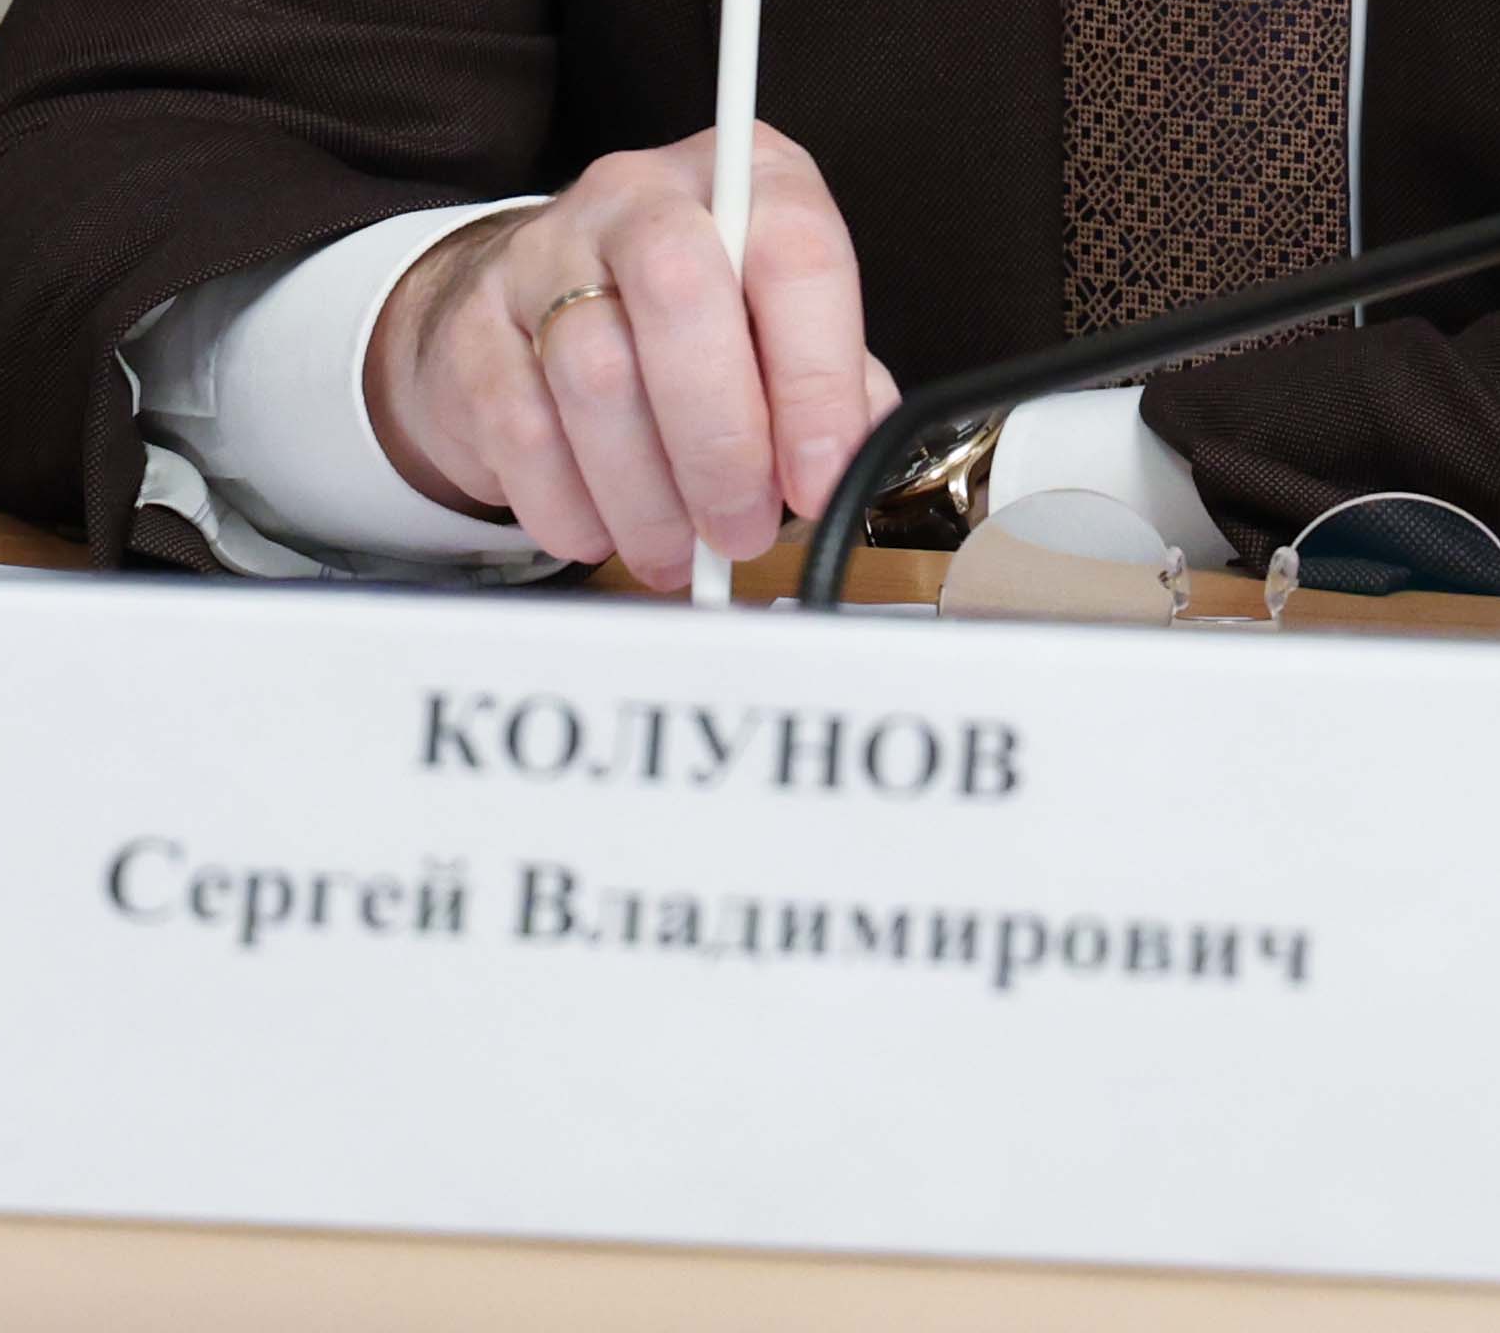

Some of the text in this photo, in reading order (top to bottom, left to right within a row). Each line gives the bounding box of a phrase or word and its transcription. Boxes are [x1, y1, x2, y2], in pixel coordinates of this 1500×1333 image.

[421, 691, 1019, 798] КОЛУНОВ
[104, 841, 1309, 990] Сергей Владимирович
